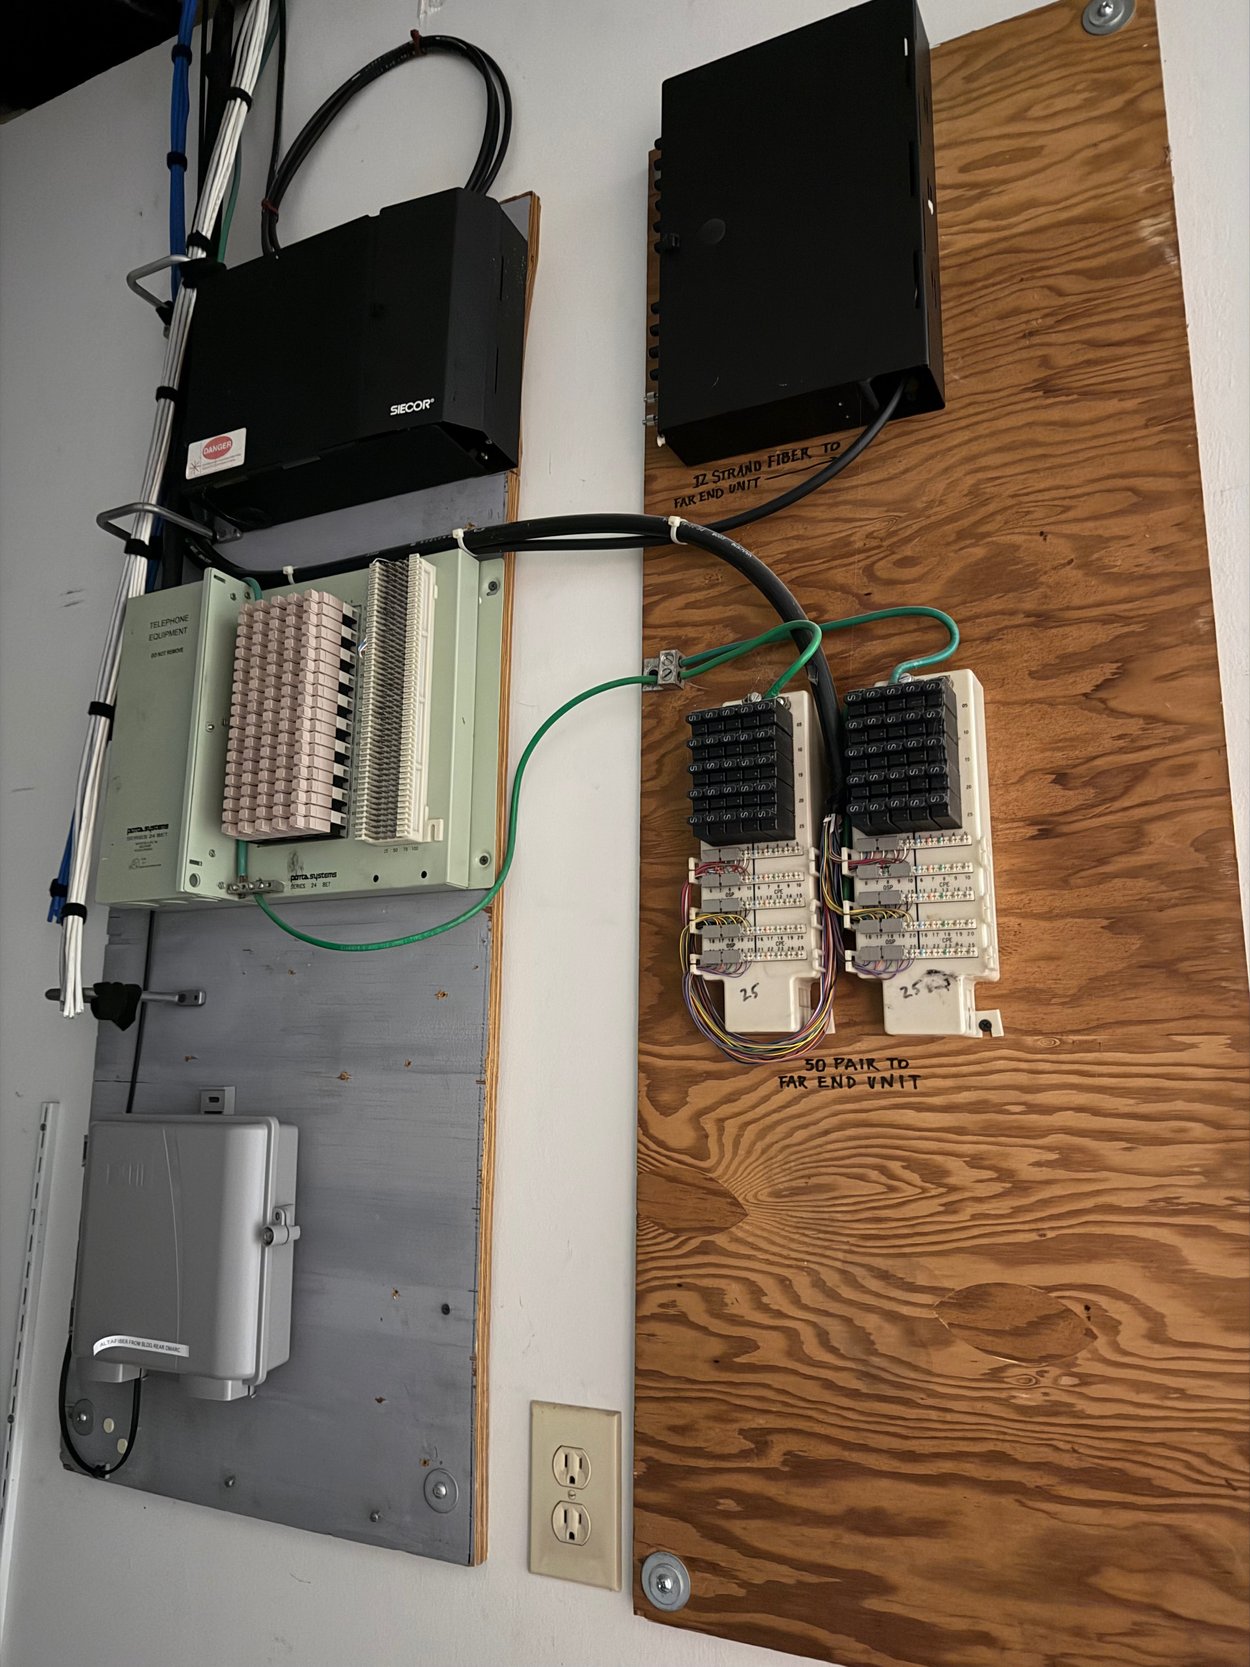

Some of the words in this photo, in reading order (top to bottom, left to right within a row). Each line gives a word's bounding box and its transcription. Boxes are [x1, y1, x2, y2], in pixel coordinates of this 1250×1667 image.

[203, 440, 231, 454] DANGER
[712, 459, 762, 483] STRAND
[768, 447, 812, 468] FIBER
[822, 441, 841, 454] TO
[674, 496, 696, 508] FAR
[698, 488, 724, 502] END
[729, 477, 761, 494] UNIT
[150, 614, 189, 629] TELEPHONE
[149, 627, 187, 641] EQUIPMENT
[740, 983, 760, 1002] 25
[900, 979, 922, 999] 25
[805, 1058, 826, 1072] 50
[834, 1057, 880, 1071] PAIR
[887, 1057, 910, 1070] TO
[778, 1076, 808, 1089] FAR
[818, 1074, 856, 1088] END
[868, 1074, 922, 1089] UNIT
